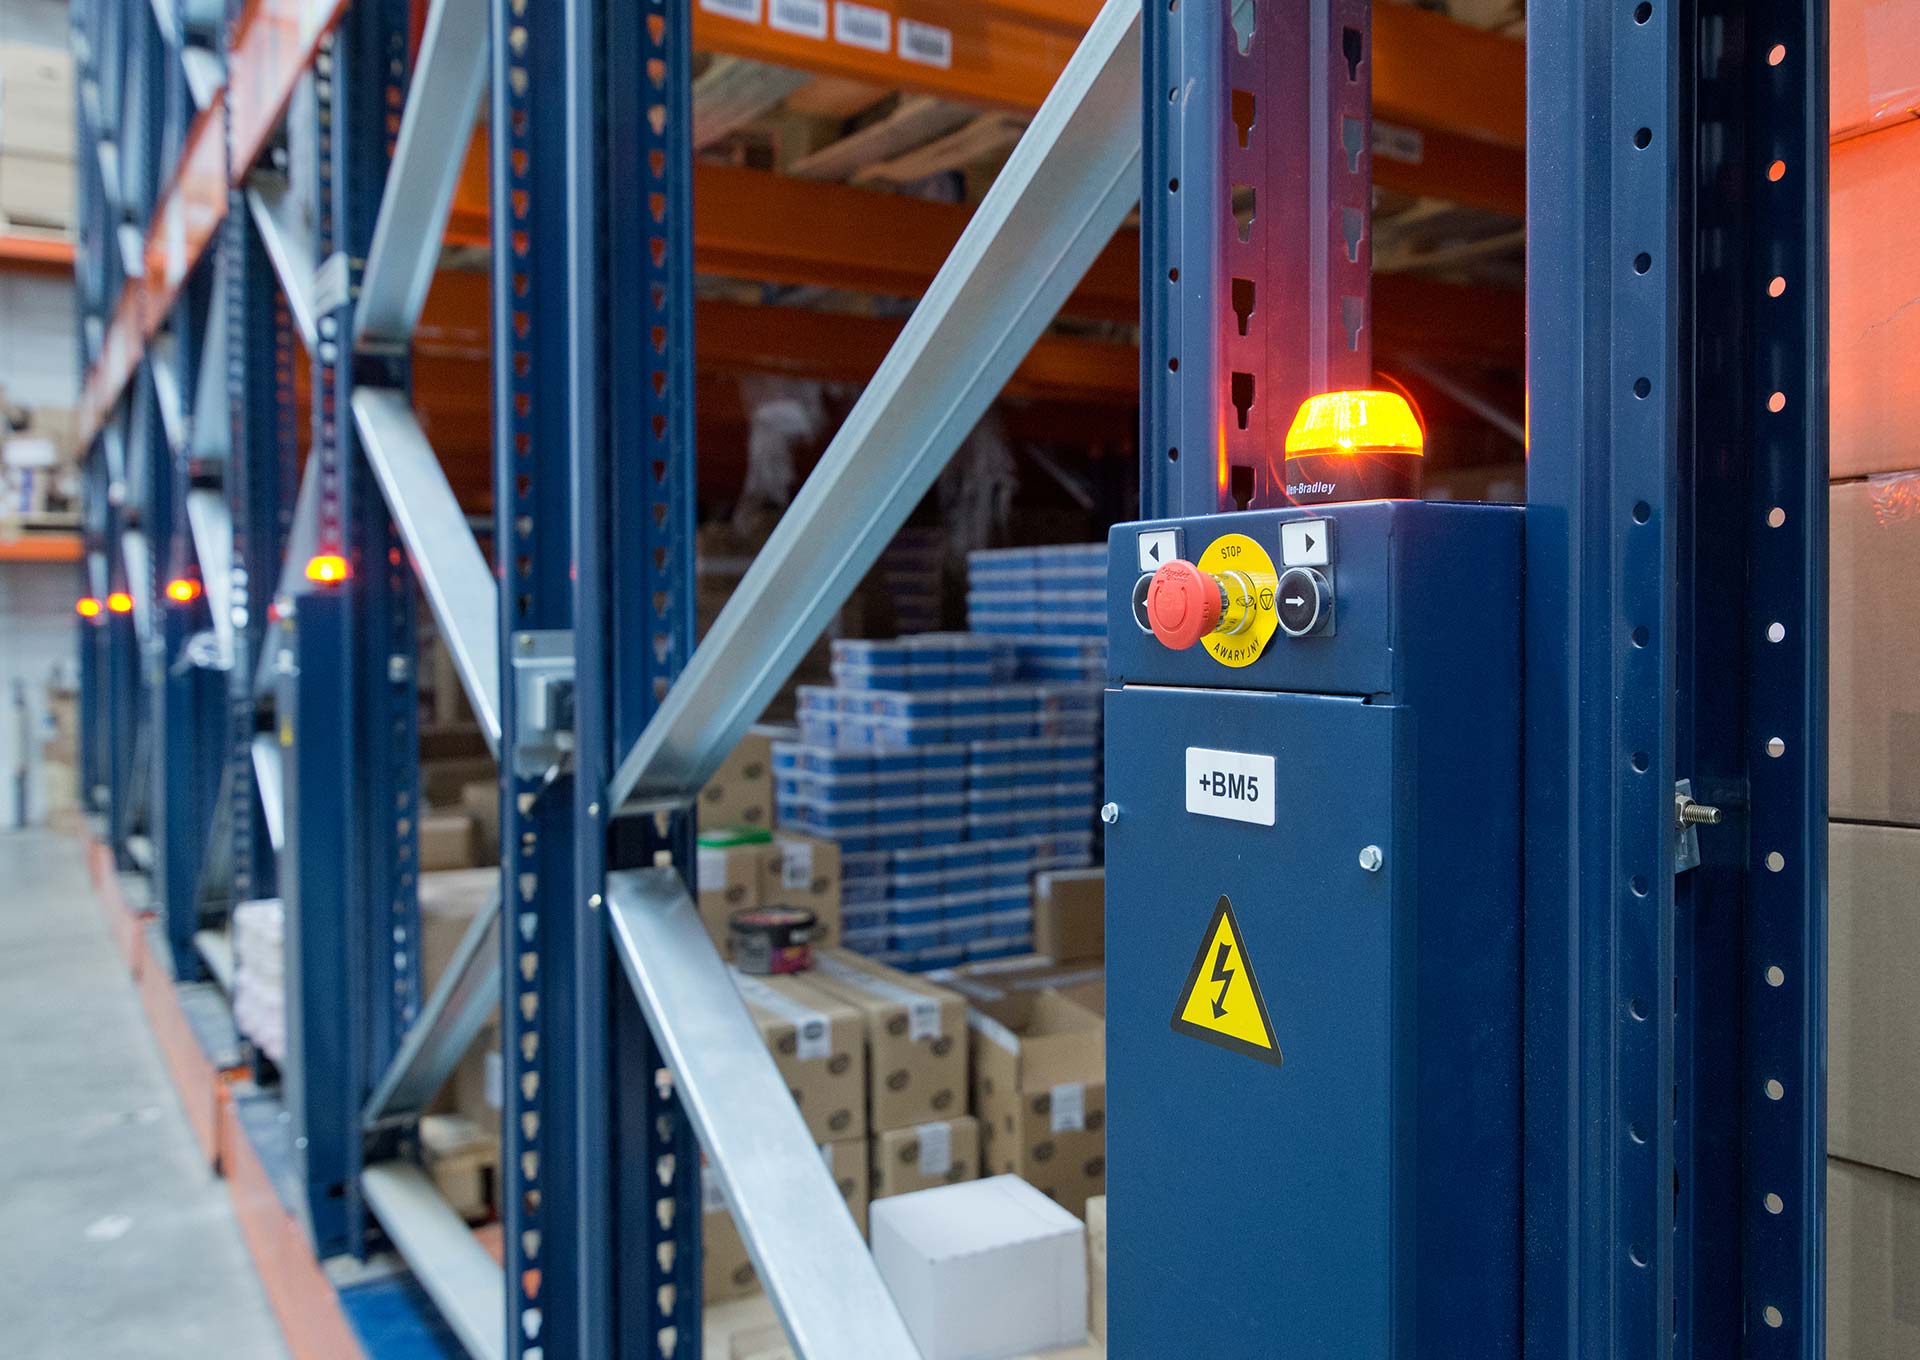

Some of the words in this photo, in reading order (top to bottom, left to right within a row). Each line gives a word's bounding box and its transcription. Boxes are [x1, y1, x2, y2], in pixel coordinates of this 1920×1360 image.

[1221, 545, 1241, 559] STOP
[1213, 637, 1259, 661] AWARYJNY
[1199, 771, 1259, 802] +BM5
